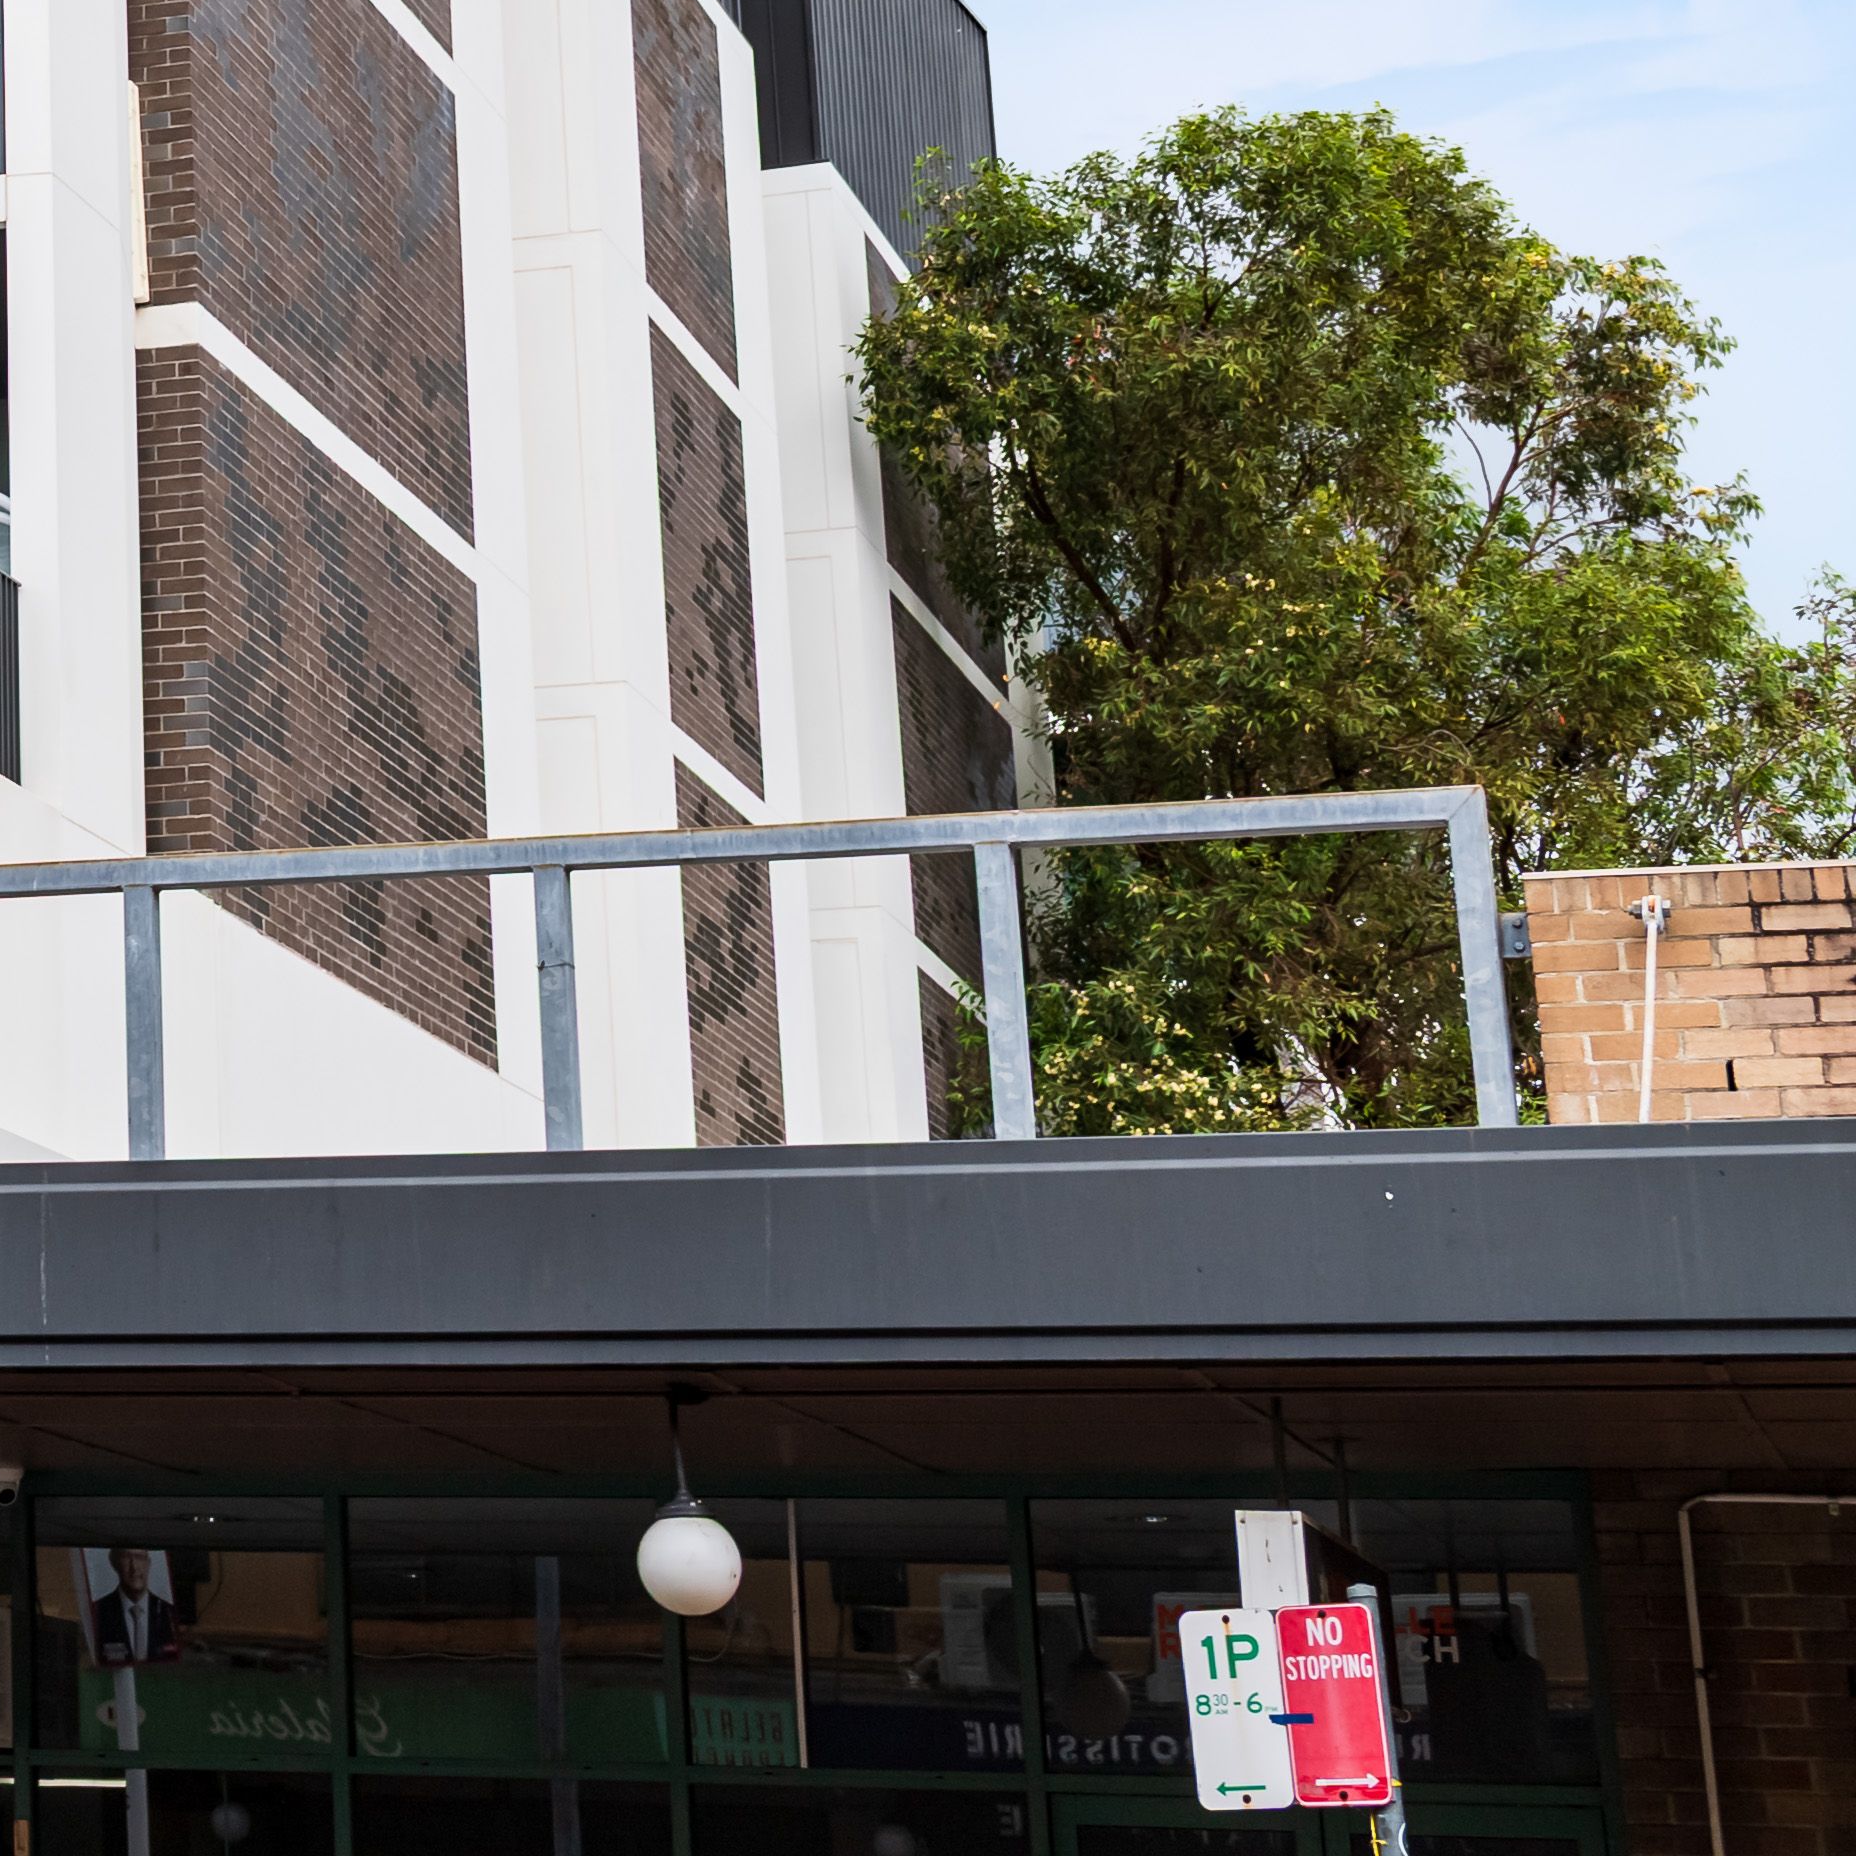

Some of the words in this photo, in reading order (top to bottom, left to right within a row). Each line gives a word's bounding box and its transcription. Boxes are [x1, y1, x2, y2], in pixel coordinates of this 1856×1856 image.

[1305, 1616, 1343, 1647] NO
[1200, 1633, 1260, 1680] 1P
[1285, 1653, 1373, 1681] STOPPING
[1246, 1692, 1263, 1714] 6
